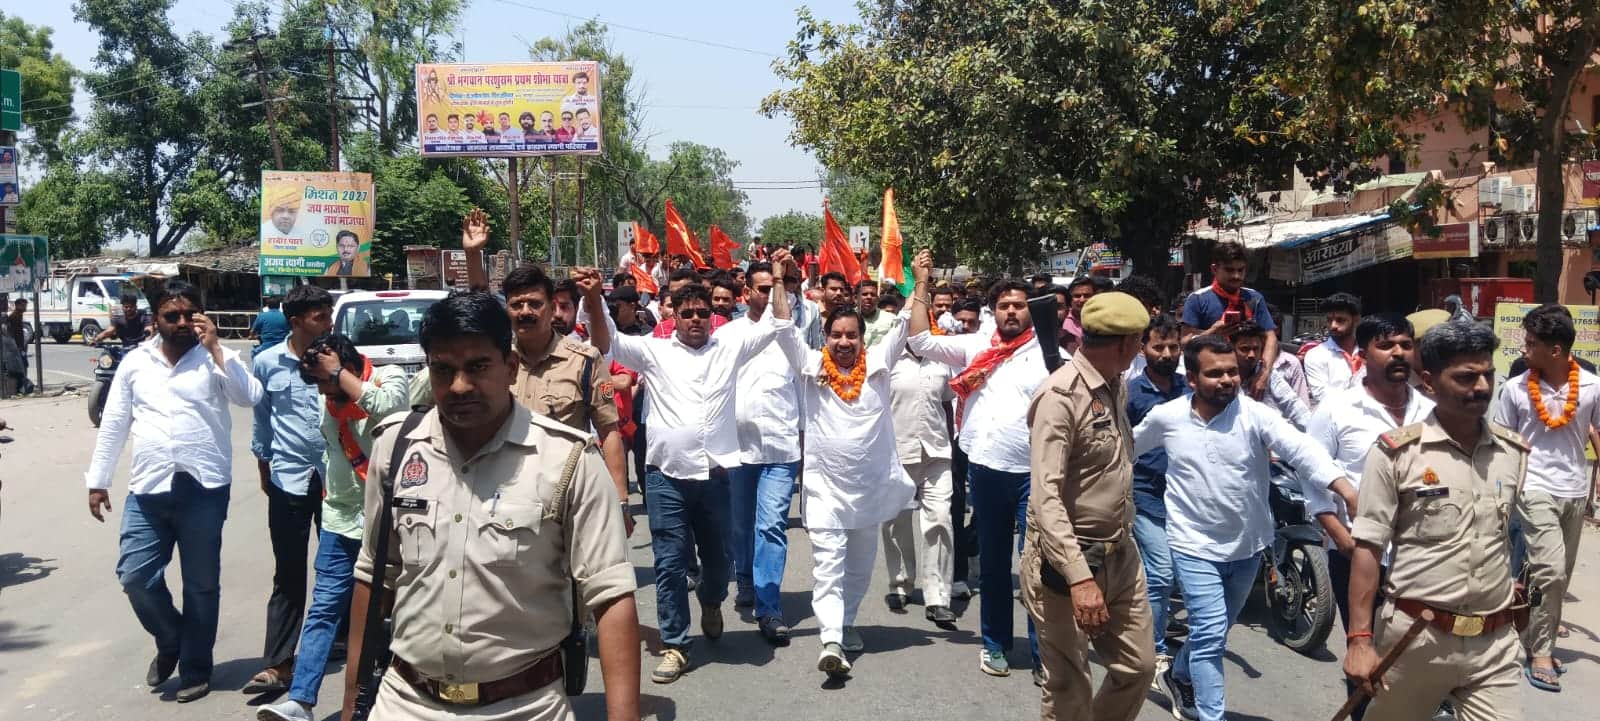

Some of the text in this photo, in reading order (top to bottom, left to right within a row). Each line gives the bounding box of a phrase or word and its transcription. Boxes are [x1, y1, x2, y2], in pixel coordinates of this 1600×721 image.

[305, 185, 368, 202] मिशन 2027
[307, 204, 321, 215] जय
